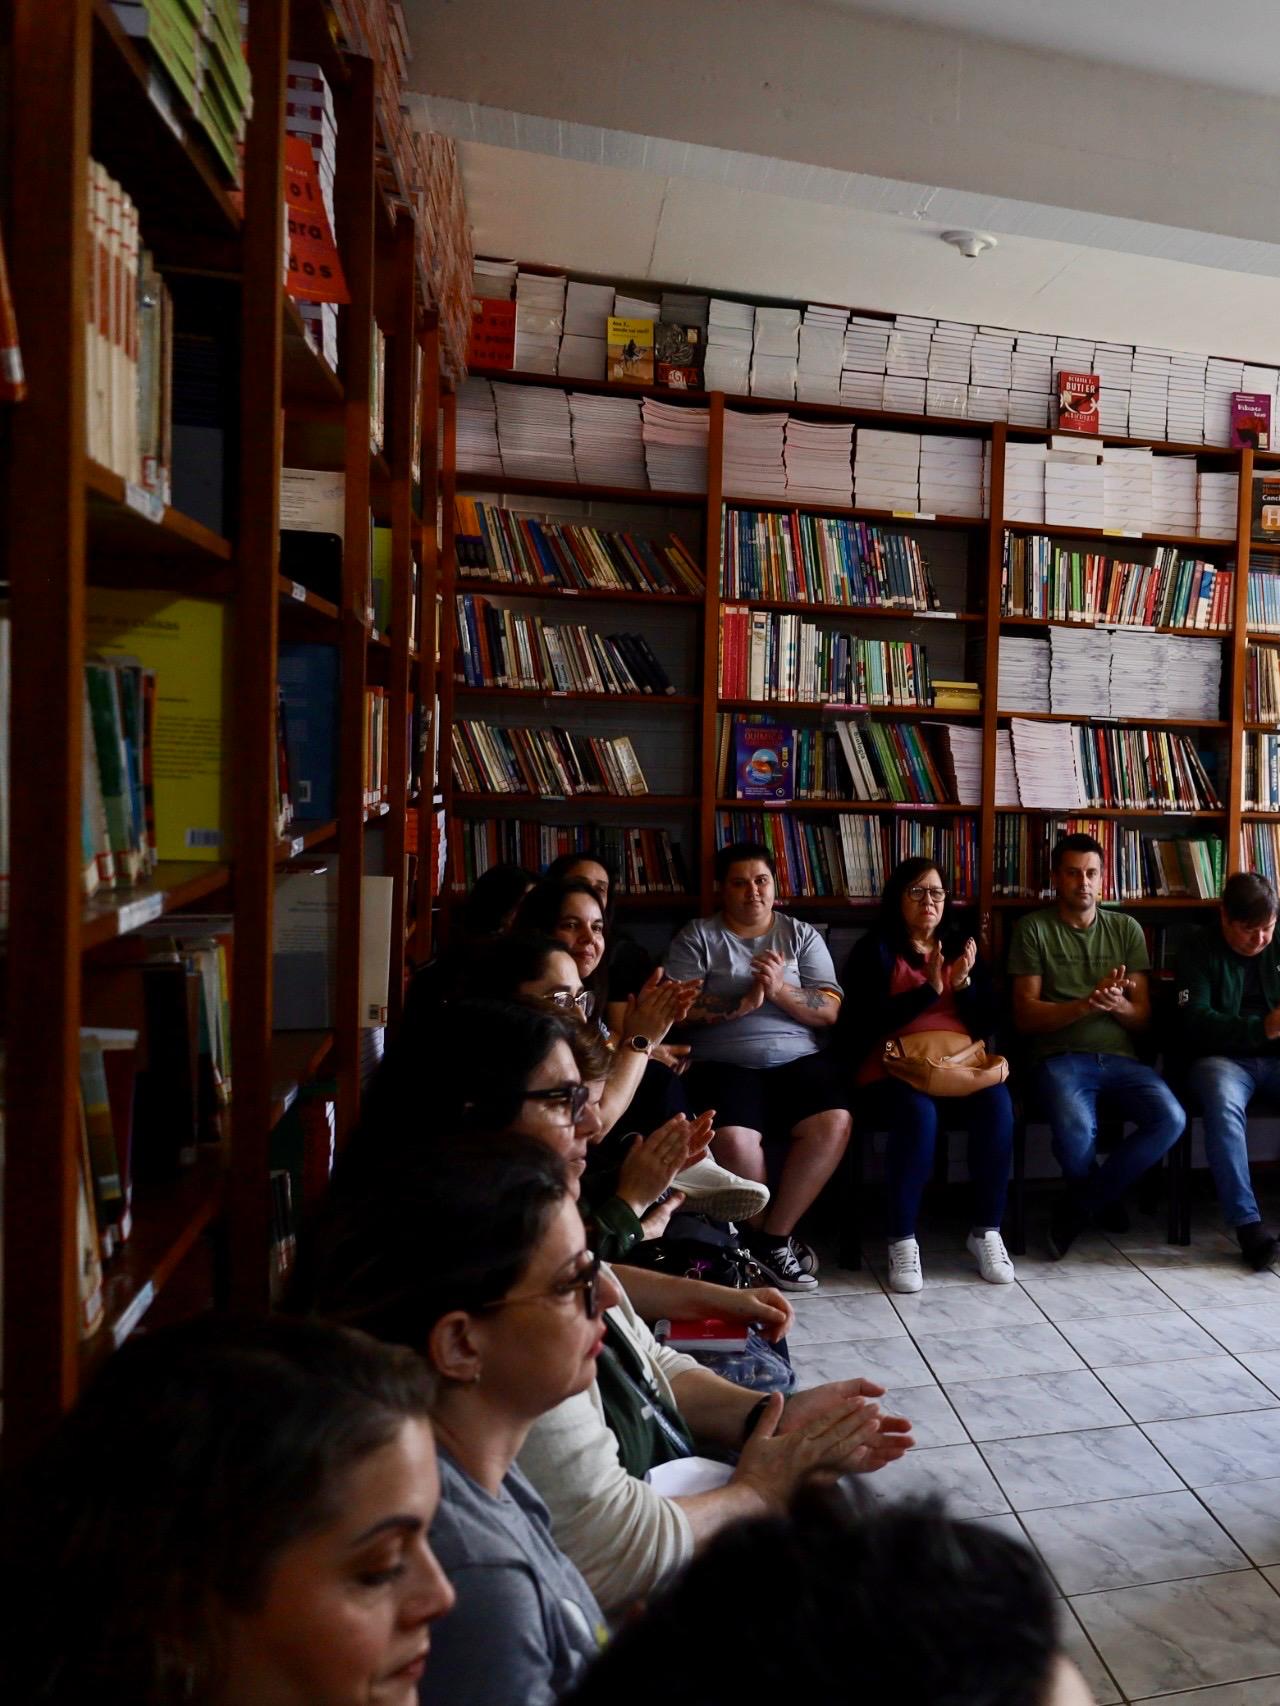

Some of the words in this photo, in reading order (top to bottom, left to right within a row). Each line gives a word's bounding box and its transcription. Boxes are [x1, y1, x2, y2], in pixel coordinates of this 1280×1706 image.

[290, 182, 313, 201] ol
[289, 220, 321, 239] ara
[289, 252, 333, 279] dos
[853, 731, 866, 760] Biologia
